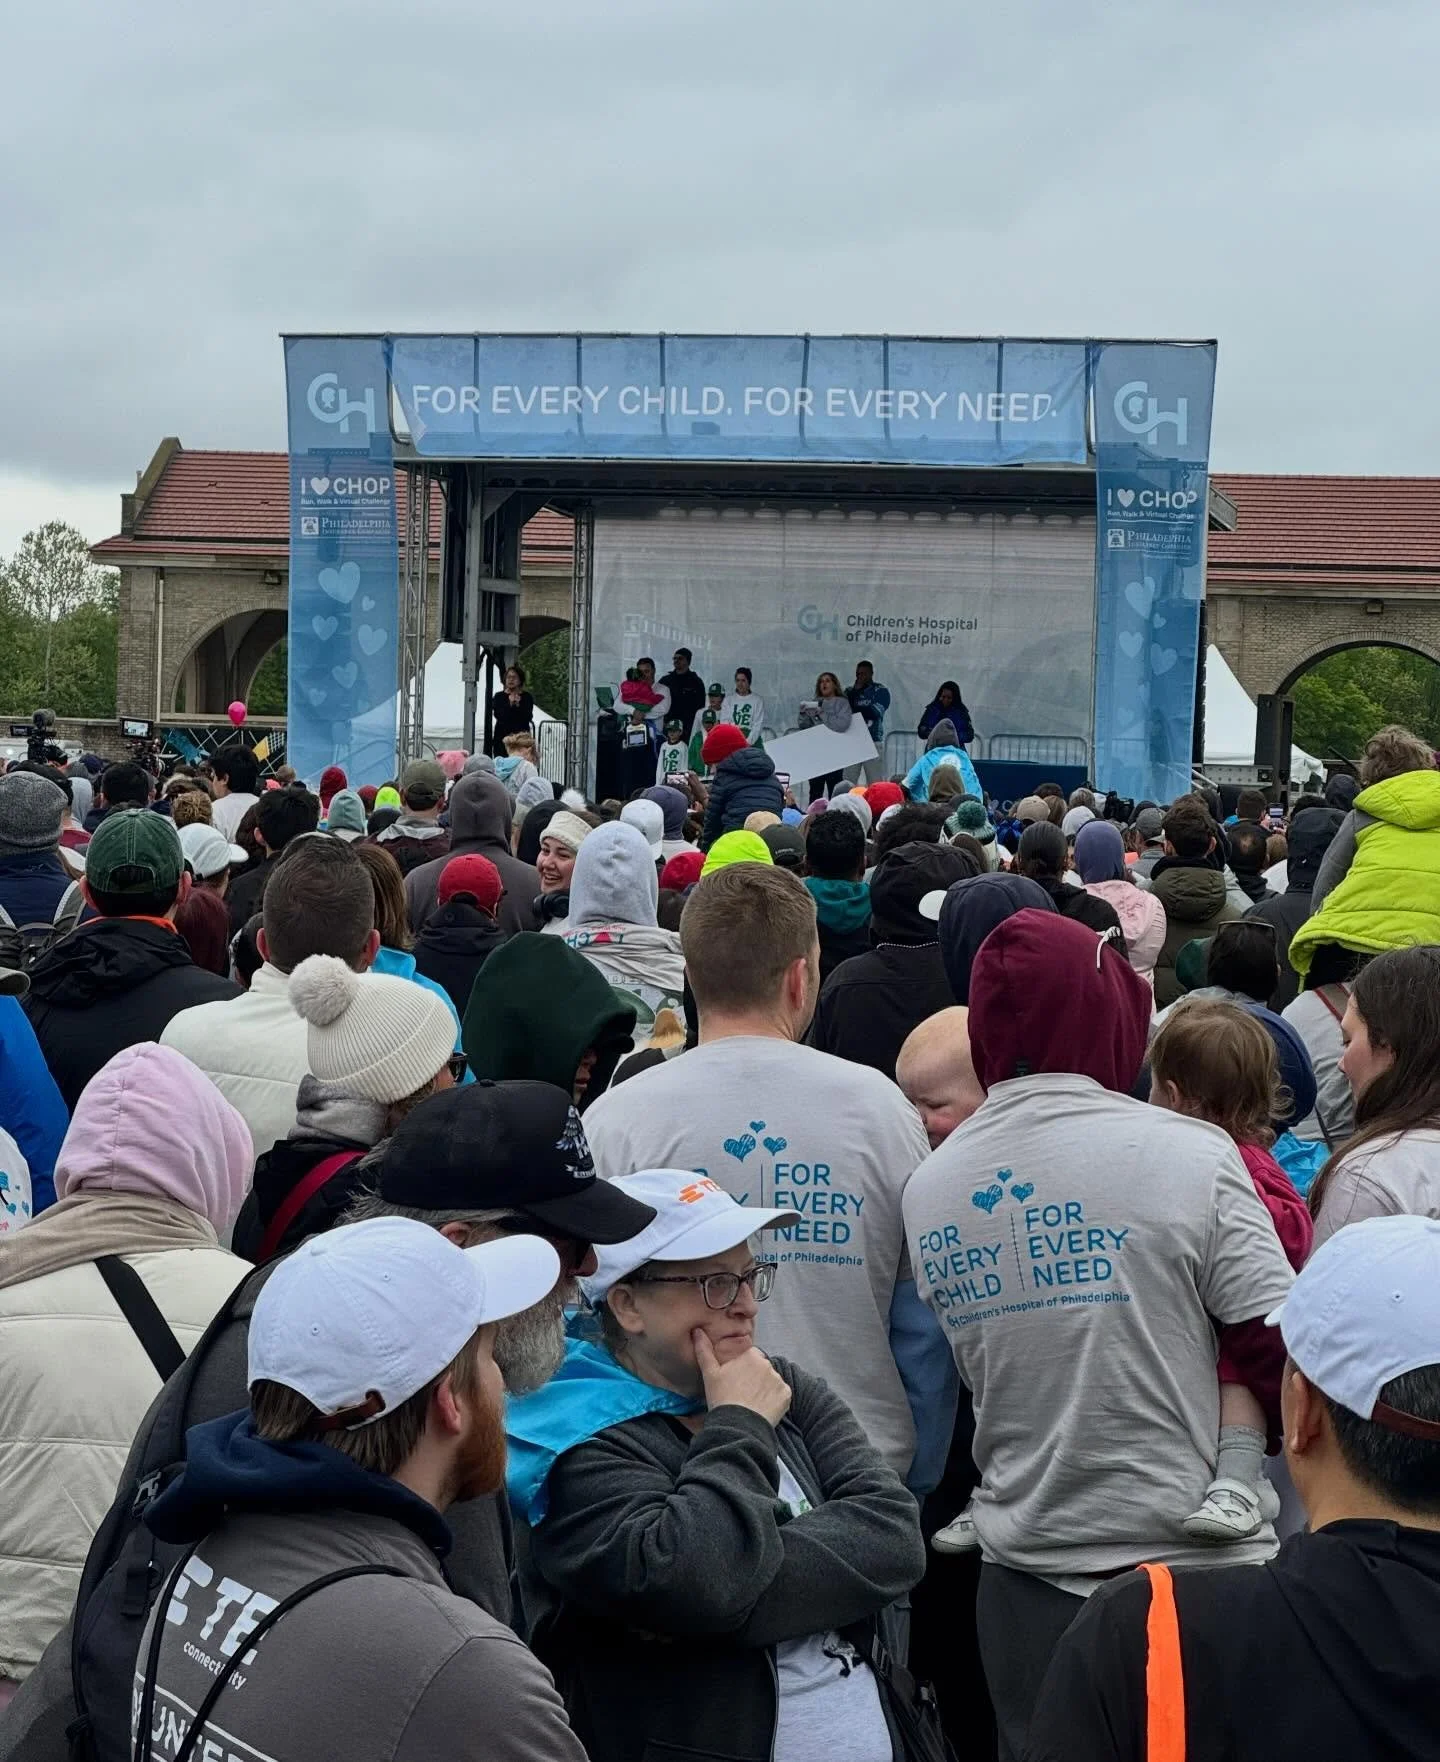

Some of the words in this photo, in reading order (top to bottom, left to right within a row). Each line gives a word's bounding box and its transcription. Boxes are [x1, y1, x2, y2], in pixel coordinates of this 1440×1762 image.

[412, 385, 481, 414] FOR
[492, 385, 608, 415] EVERY
[618, 385, 733, 415] CHILD.
[744, 386, 814, 416] FOR
[826, 388, 948, 420] EVERY
[957, 391, 1057, 422] NEED.
[301, 478, 306, 495] I
[333, 477, 391, 495] CHOP
[1107, 488, 1112, 506] I
[1139, 490, 1198, 509] CHOP
[846, 631, 861, 642] of
[865, 631, 952, 646] Philadelphia
[847, 615, 914, 628] Children's
[919, 616, 977, 632] Hospital
[774, 1163, 831, 1186] FOR
[774, 1191, 865, 1217] EVERY
[1025, 1201, 1084, 1232] FOR
[773, 1220, 851, 1244] NEED
[919, 1225, 962, 1258] FOR
[1028, 1228, 1129, 1260] EVERY
[781, 1253, 792, 1262] of
[794, 1252, 863, 1266] Philadelphia
[924, 1243, 1002, 1285] EVERY
[1032, 1257, 1113, 1289] NEED
[933, 1273, 1003, 1312] CHILD
[960, 1307, 1000, 1326] Children's
[1002, 1299, 1044, 1315] Hospital
[1047, 1297, 1057, 1307] of
[1061, 1291, 1130, 1306] Philadelphia
[183, 1641, 247, 1691] connectiity
